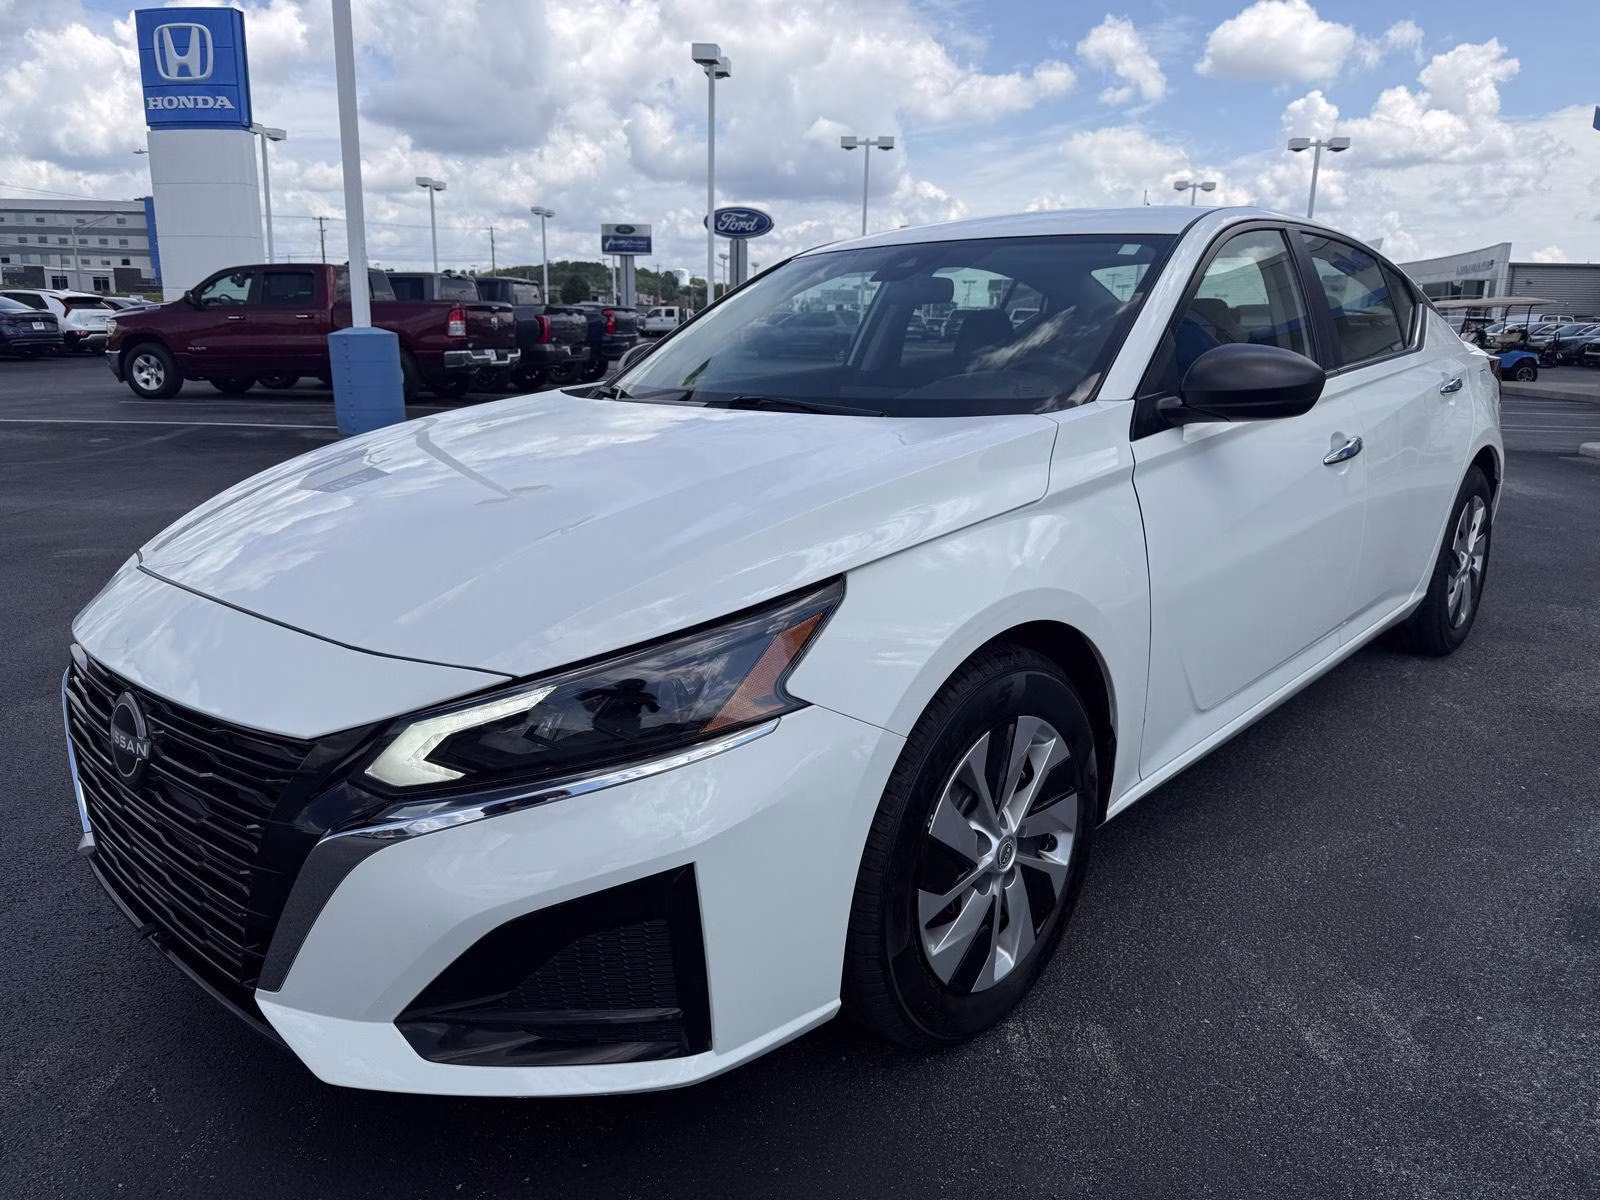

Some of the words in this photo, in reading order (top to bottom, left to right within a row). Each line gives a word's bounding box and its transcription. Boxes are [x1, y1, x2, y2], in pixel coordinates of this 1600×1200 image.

[146, 95, 235, 110] HONDA
[717, 212, 759, 231] Ford
[112, 728, 147, 757] ISSAN
